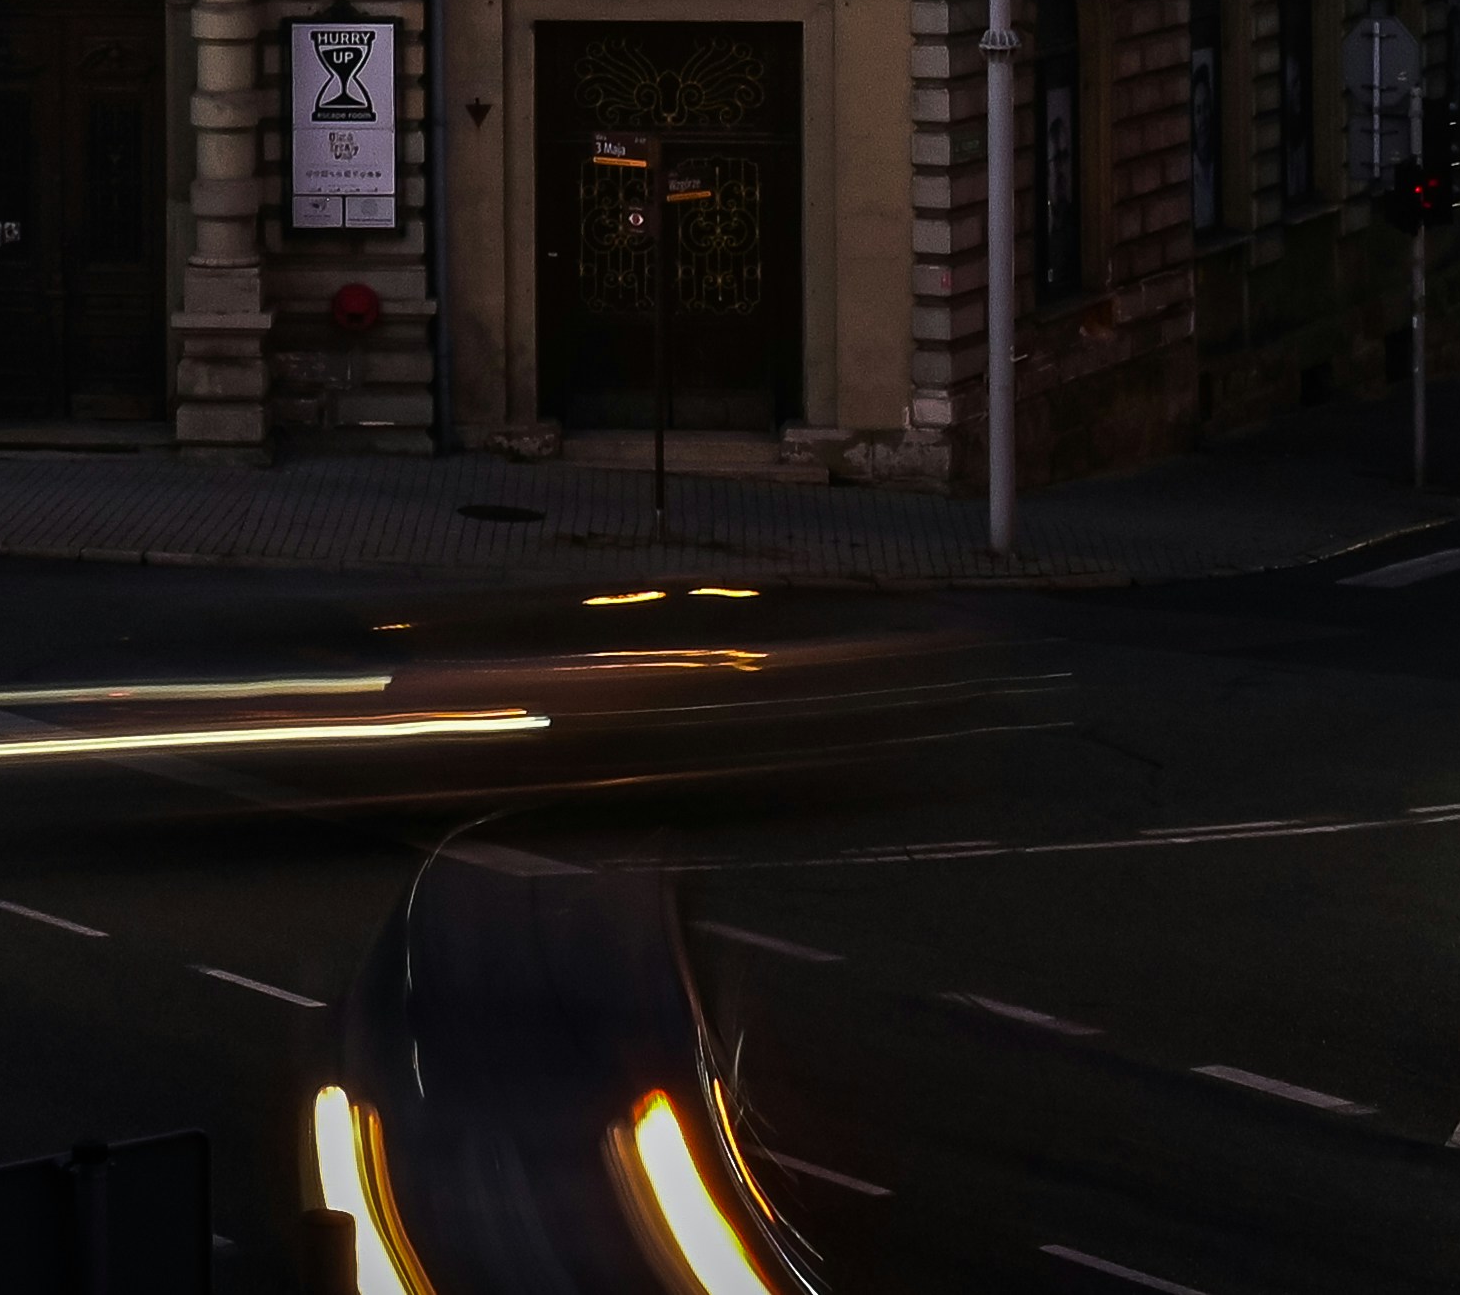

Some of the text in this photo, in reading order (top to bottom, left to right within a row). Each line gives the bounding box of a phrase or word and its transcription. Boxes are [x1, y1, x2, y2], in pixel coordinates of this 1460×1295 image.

[317, 32, 371, 45] HURRY
[332, 50, 354, 64] UP
[595, 142, 626, 157] 3 Maja
